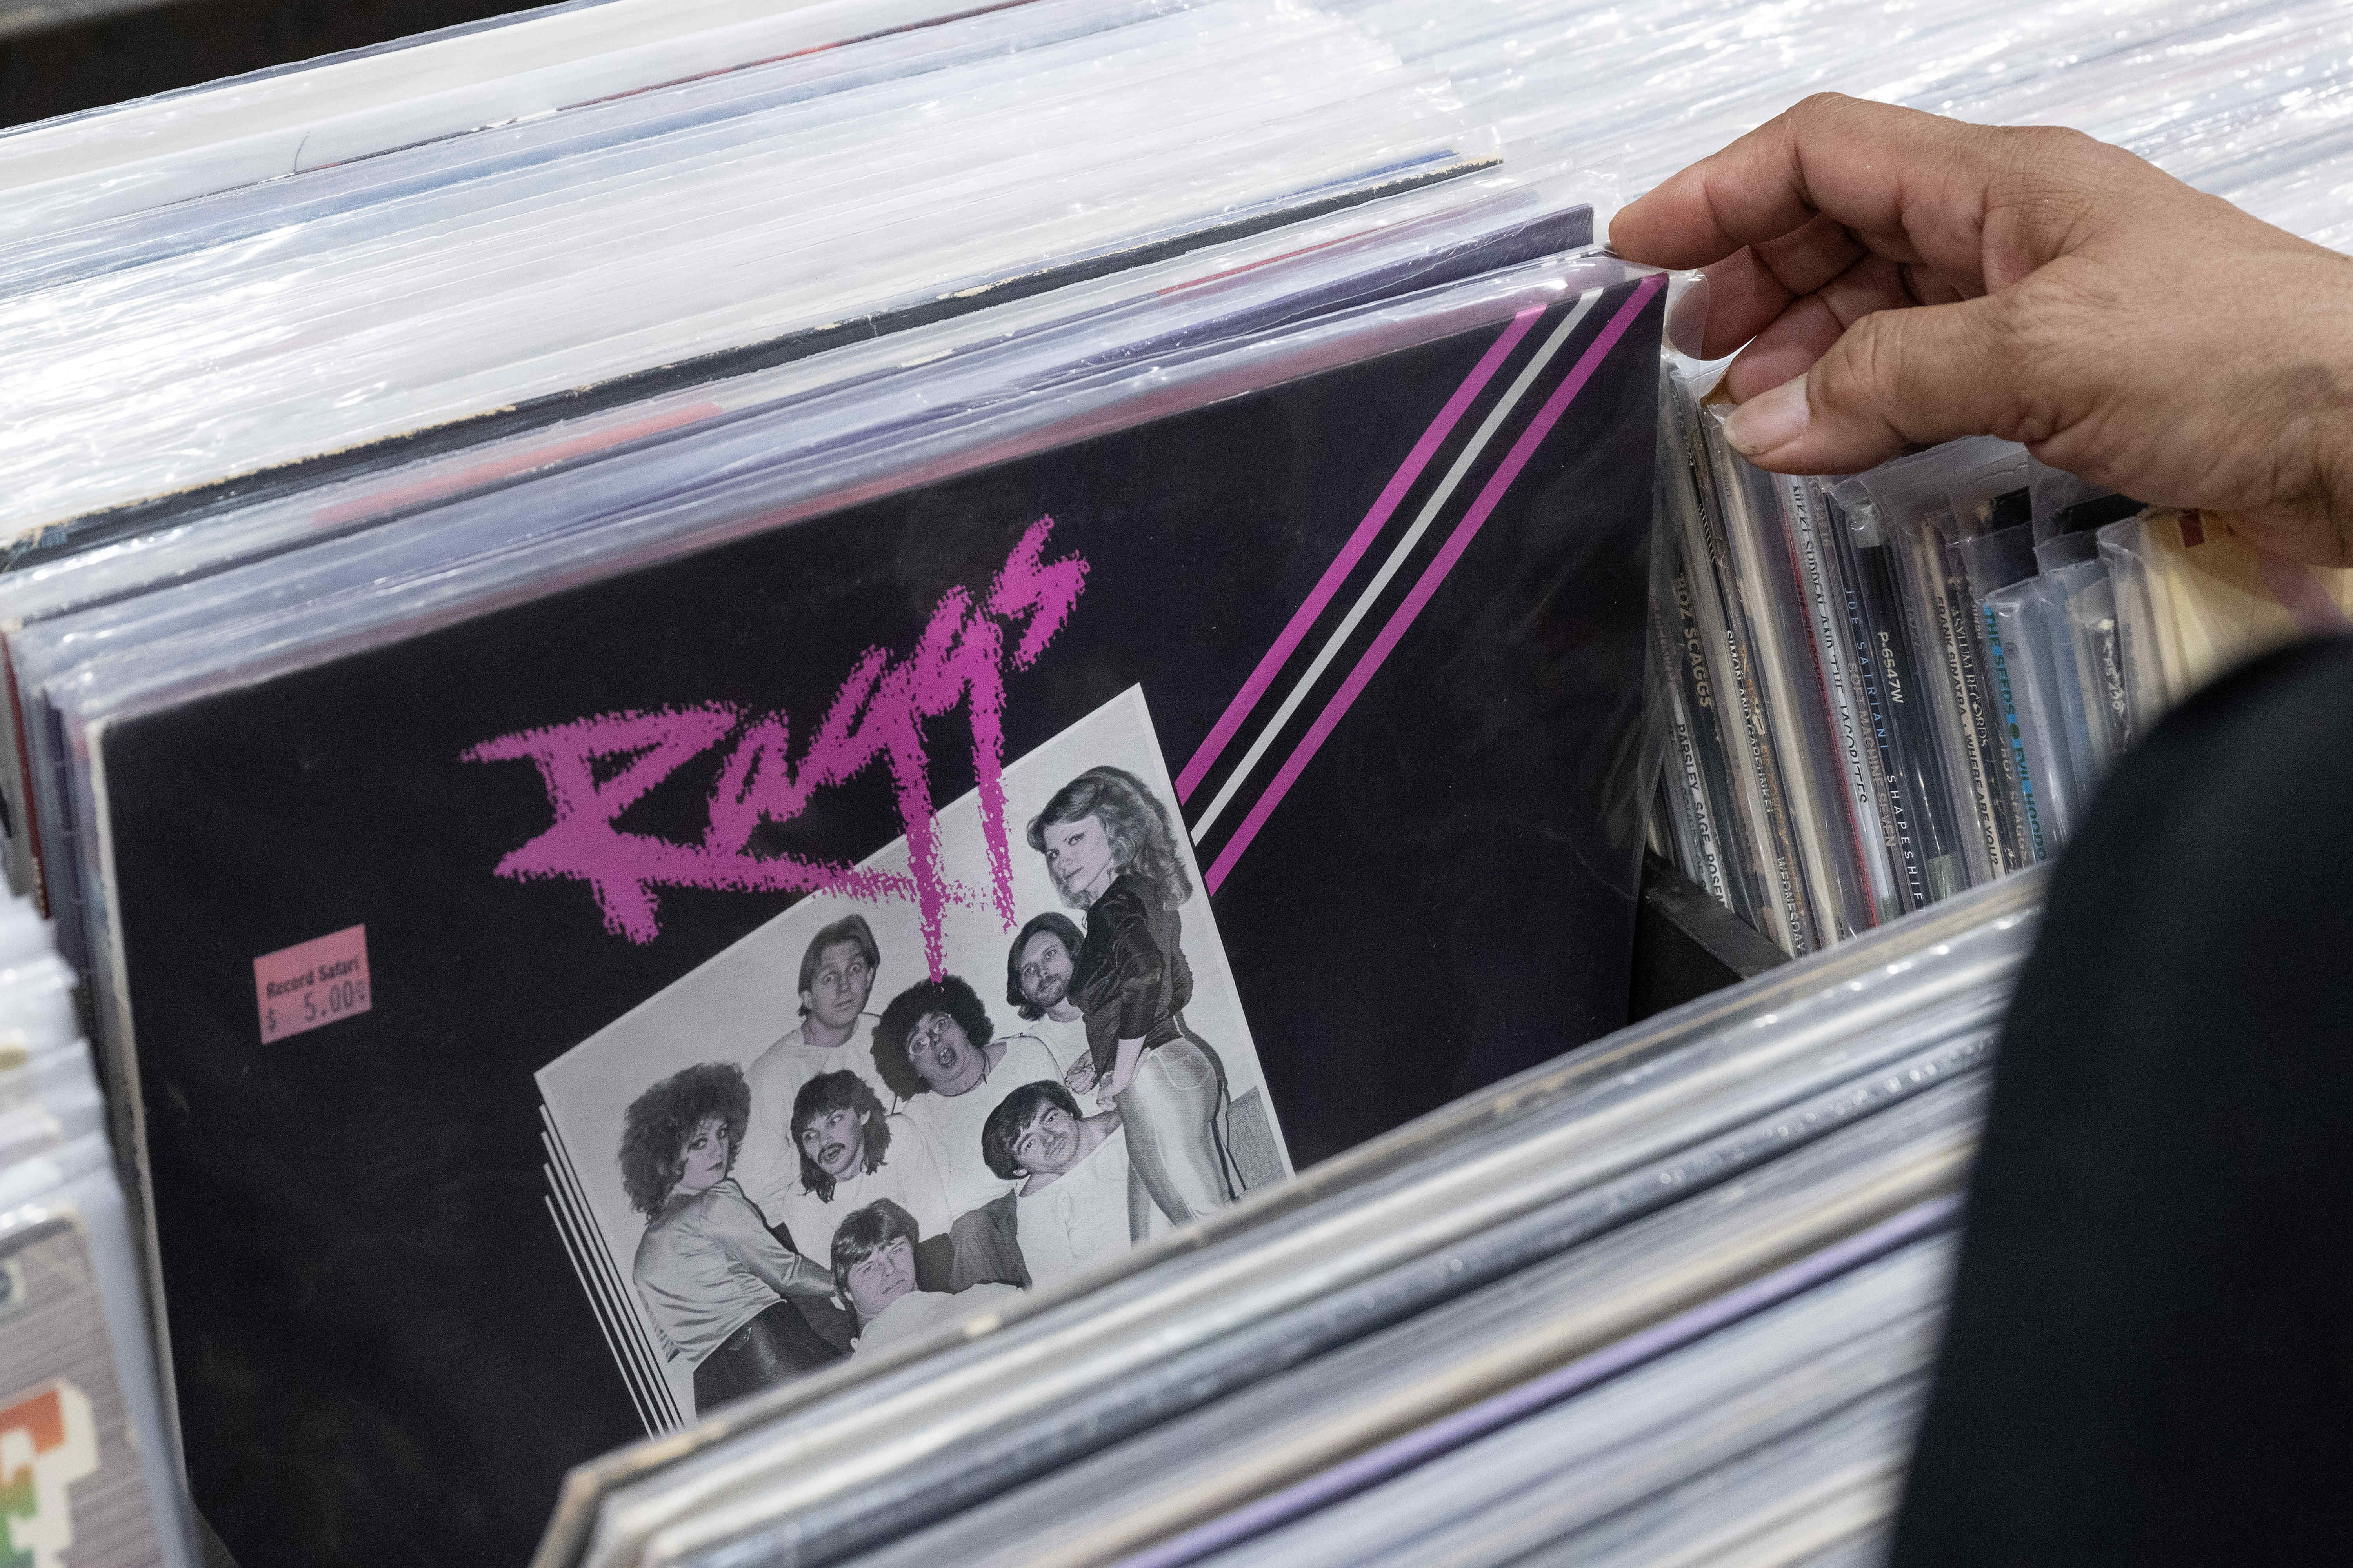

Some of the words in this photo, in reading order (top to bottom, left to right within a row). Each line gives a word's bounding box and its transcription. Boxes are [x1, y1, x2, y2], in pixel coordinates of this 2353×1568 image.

[1684, 628, 1713, 708] SCAGGS
[1846, 590, 1859, 624] JOE
[1858, 642, 1889, 748] SATRIANI
[1878, 631, 1904, 704] P-6547W
[1938, 597, 1953, 647] FRANK
[1948, 652, 1967, 715] SINATRA
[1964, 734, 1982, 788] WHERE
[1977, 789, 1990, 822] ARE
[1985, 826, 1998, 865] YOU?
[1985, 612, 2000, 646] THE
[1995, 655, 2015, 715] SEEDS
[2017, 748, 2029, 781] EVIL
[1676, 723, 1699, 791] PARSLEY
[1694, 801, 1710, 843] SAGE
[1727, 630, 1744, 680] SIMON
[1740, 689, 1751, 721] AND
[1777, 857, 1806, 951] WEDNESDAY
[1847, 663, 1865, 703] SOFT
[1859, 710, 1882, 786] MACHINE
[1878, 793, 1896, 847] SEVEN
[267, 969, 314, 999] Record
[318, 956, 359, 982] Safari
